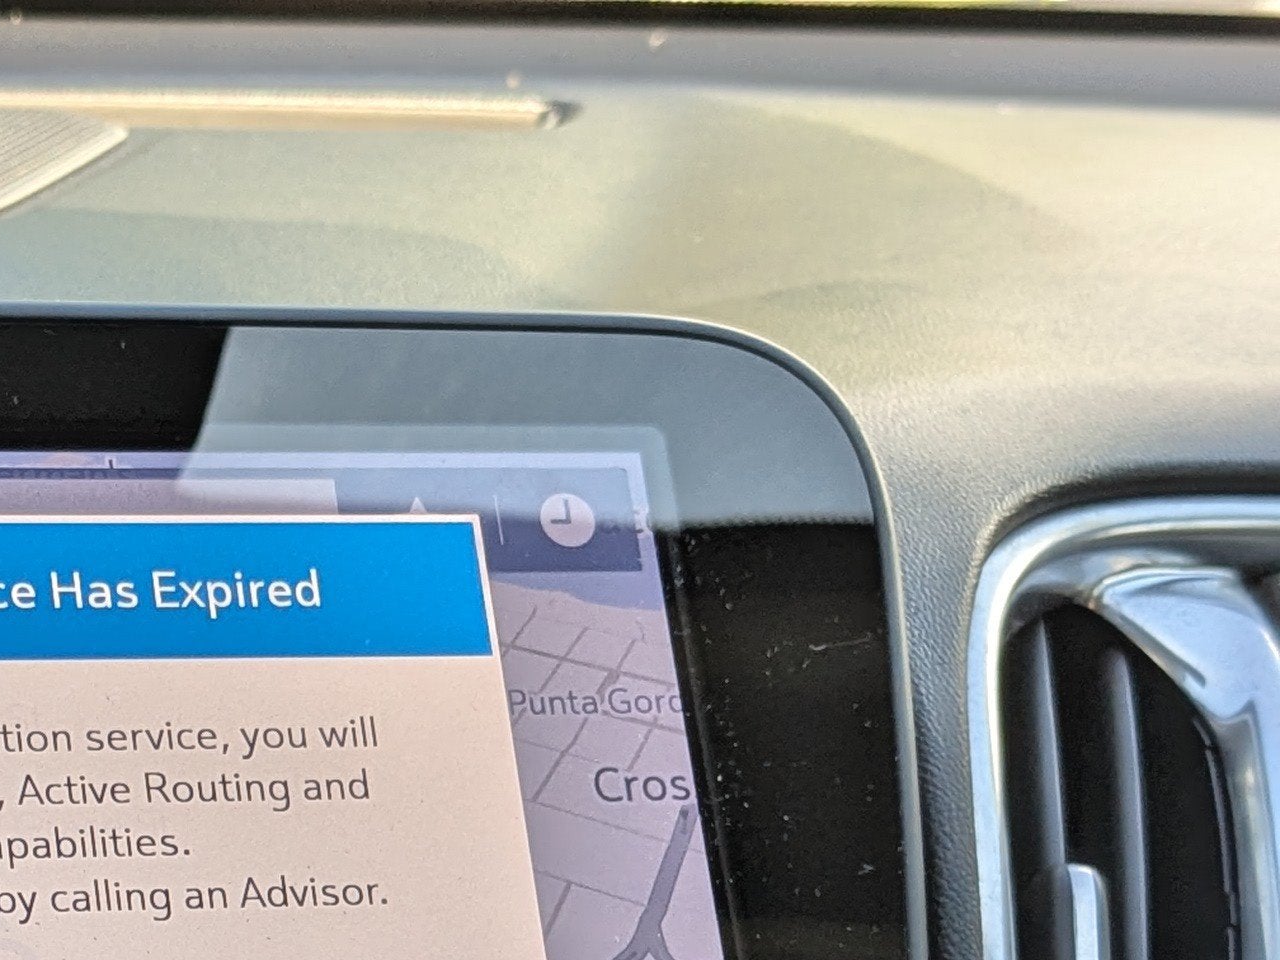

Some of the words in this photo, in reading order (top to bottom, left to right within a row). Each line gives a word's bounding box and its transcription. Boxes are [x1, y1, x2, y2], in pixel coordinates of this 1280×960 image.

[50, 571, 139, 609] Has
[151, 568, 321, 620] Expired
[508, 688, 599, 716] Punta
[85, 721, 230, 755] service,
[239, 727, 308, 760] you
[318, 715, 378, 748] will
[18, 774, 131, 806] Active
[144, 771, 291, 812] Routing
[303, 767, 370, 801] and
[594, 766, 691, 803] Cros
[50, 878, 172, 922] calling
[185, 887, 228, 910] an
[240, 874, 388, 909] Advisor.
